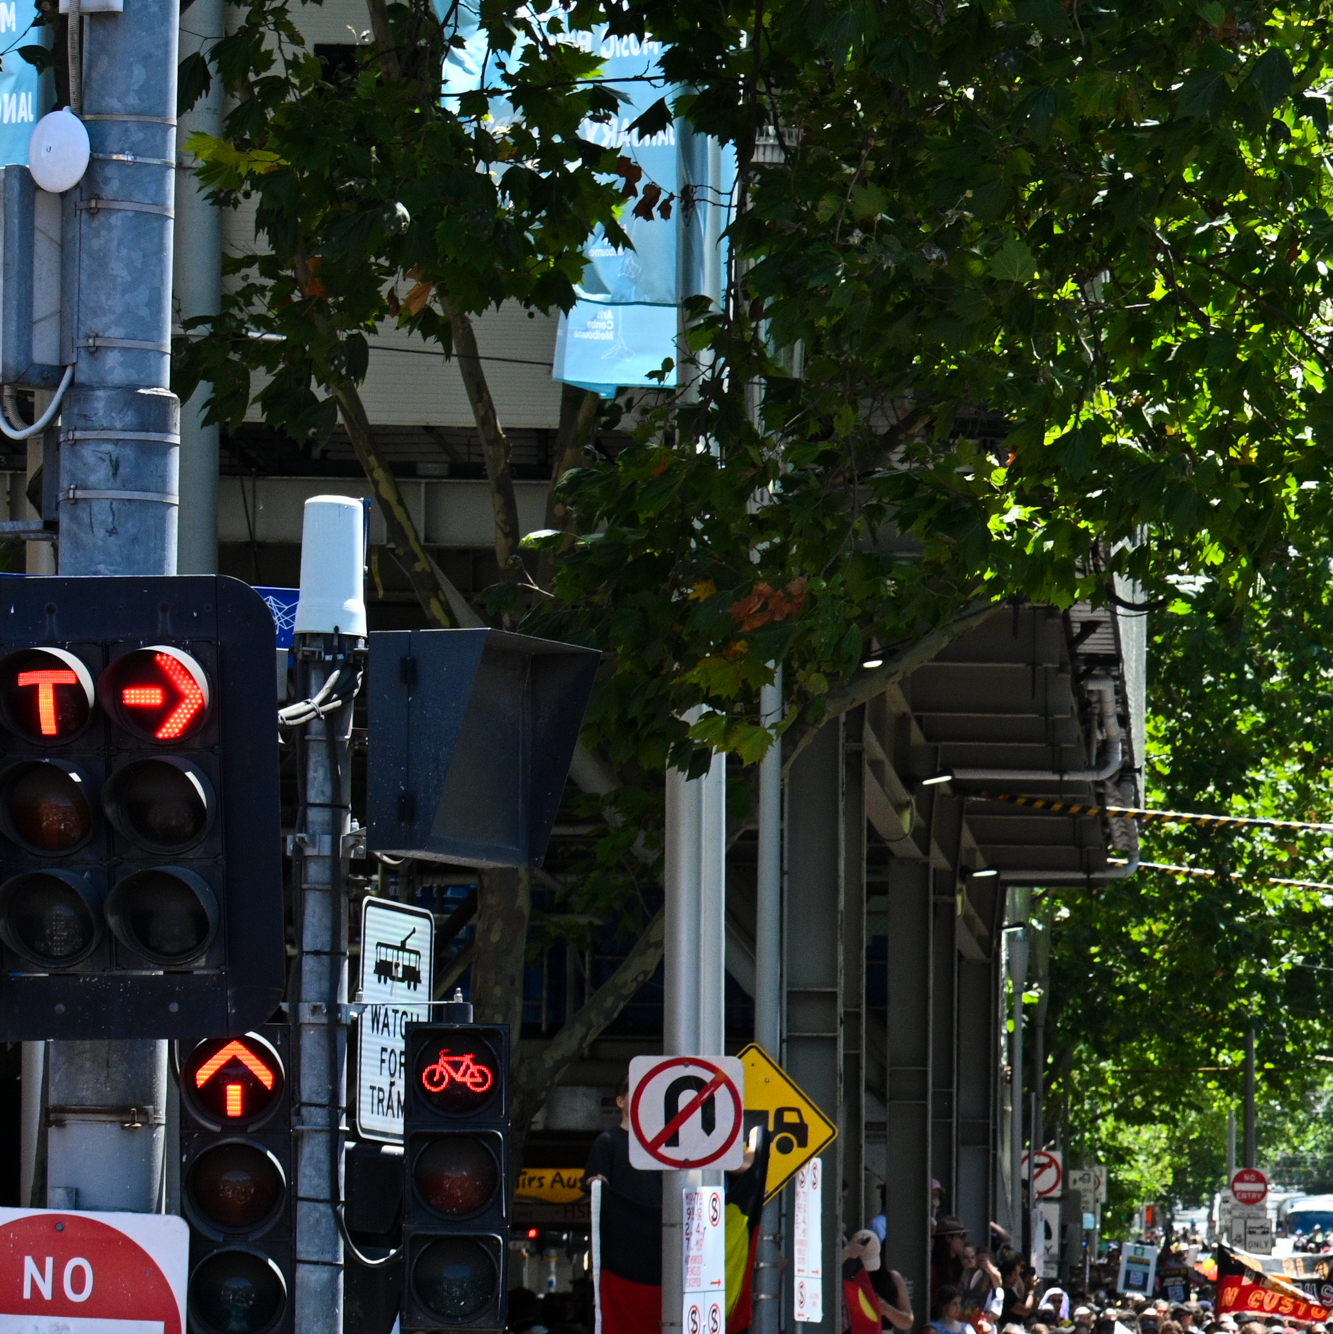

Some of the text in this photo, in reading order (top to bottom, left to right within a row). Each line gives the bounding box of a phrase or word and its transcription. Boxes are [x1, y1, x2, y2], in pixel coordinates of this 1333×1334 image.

[369, 1085, 405, 1119] TRAM
[1243, 1173, 1256, 1181] NO
[1248, 1241, 1268, 1249] ONLY
[22, 1256, 94, 1303] NO
